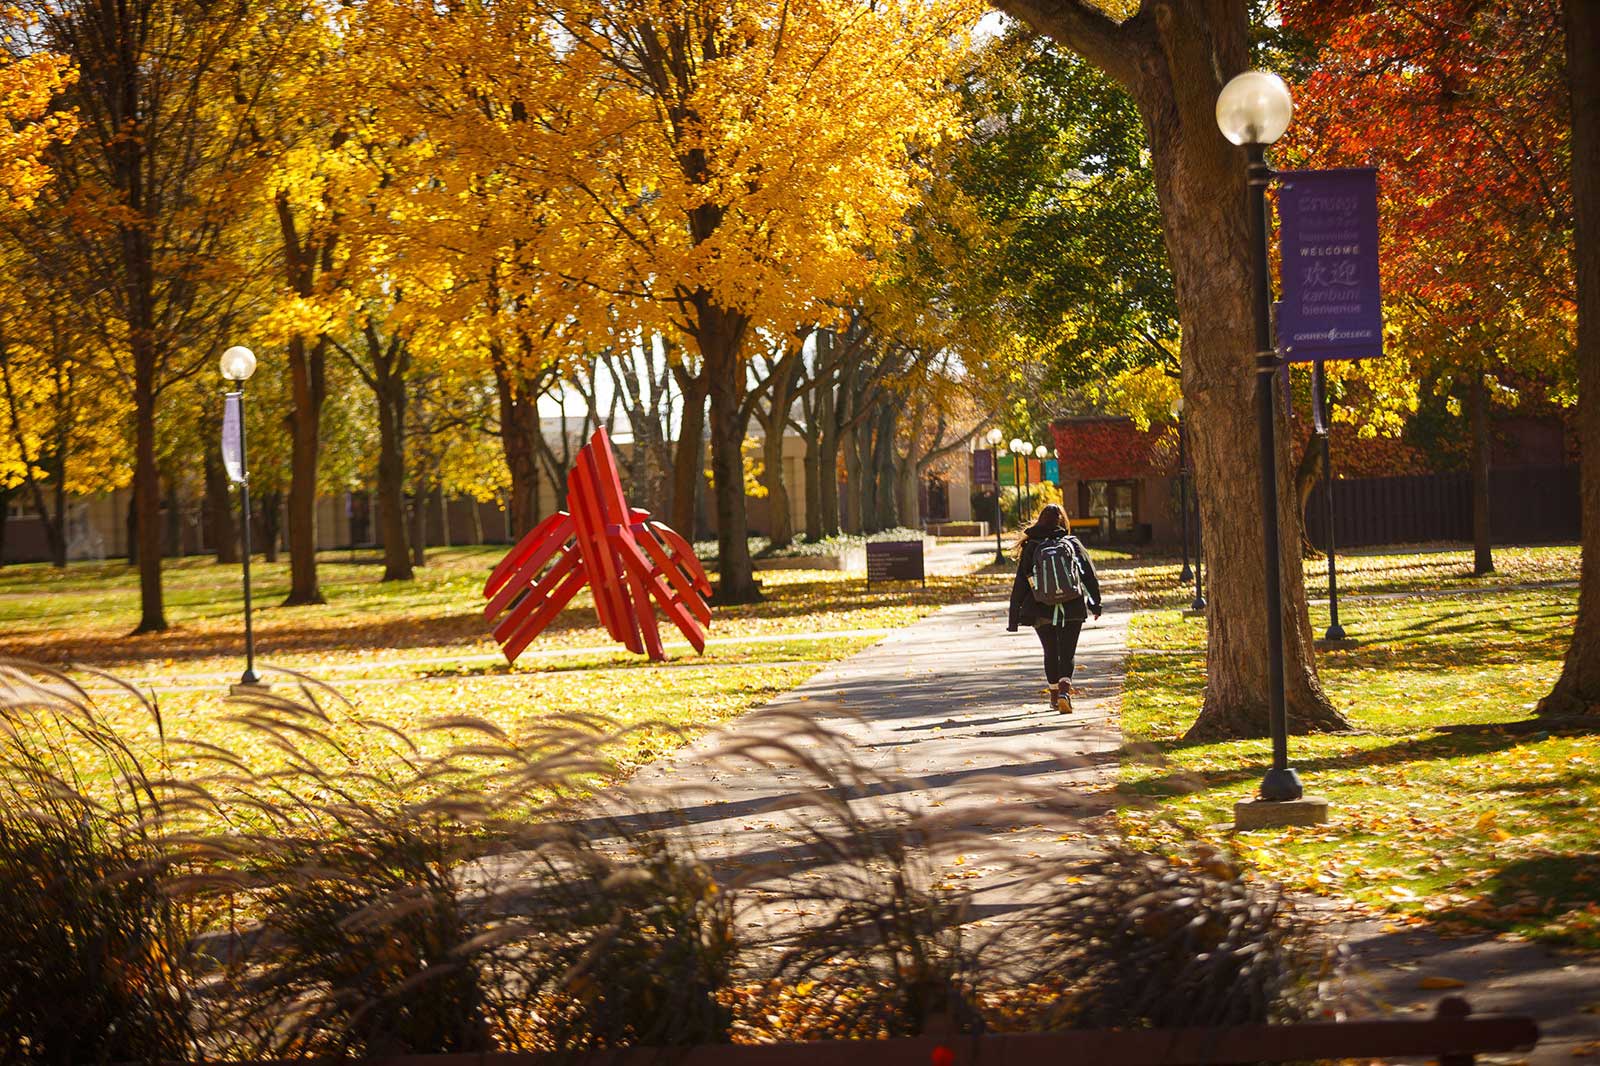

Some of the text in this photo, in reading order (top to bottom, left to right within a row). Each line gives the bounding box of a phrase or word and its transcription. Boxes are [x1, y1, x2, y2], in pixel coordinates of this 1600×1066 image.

[1300, 245, 1360, 256] WELCOME
[1303, 260, 1360, 287] 欢迎
[1335, 329, 1372, 339] COLLEGE
